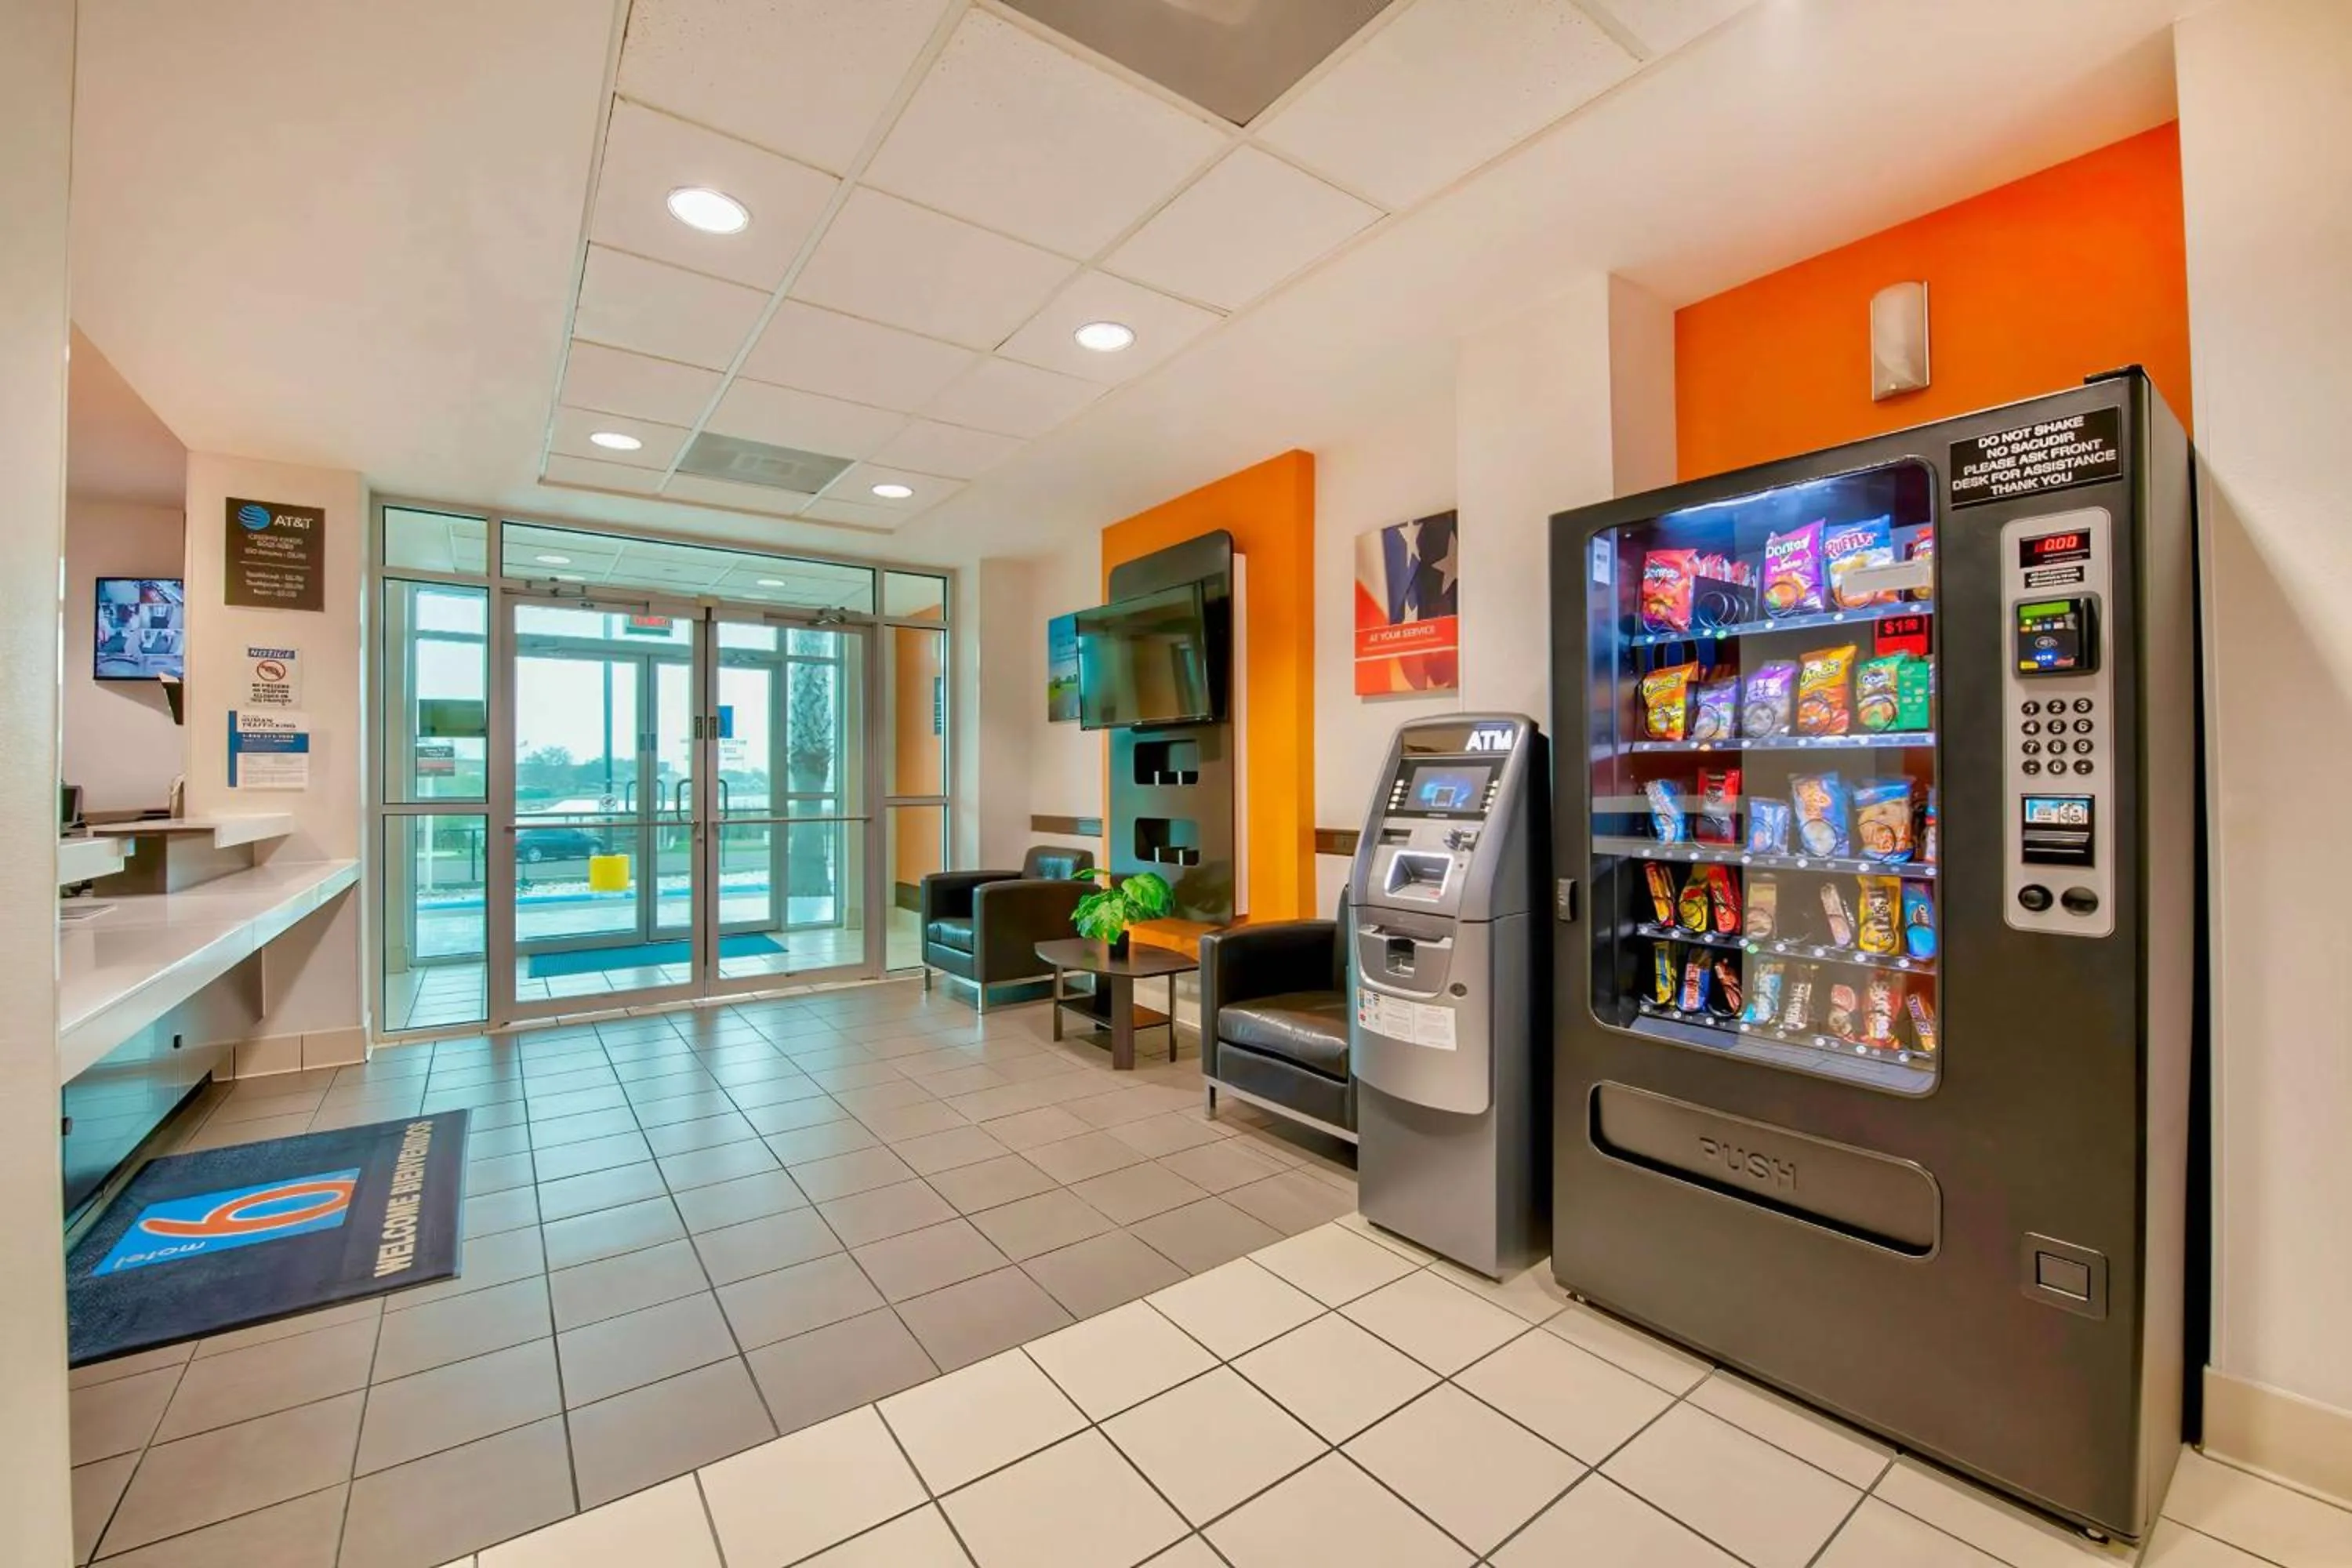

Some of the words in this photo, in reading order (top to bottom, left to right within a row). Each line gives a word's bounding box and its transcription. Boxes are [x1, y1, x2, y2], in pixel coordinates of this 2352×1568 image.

[1978, 435, 1999, 448] DO
[2002, 427, 2032, 443] NOT
[2034, 416, 2085, 436] SHAKE
[1987, 446, 2008, 459] NO
[2011, 431, 2075, 455] SACUDIR
[1963, 456, 2016, 476] PLEASE
[2019, 449, 2049, 469] ASK
[2050, 438, 2103, 459] FRONT
[1952, 475, 1989, 491] DESK
[1991, 468, 2020, 484] FOR
[2024, 449, 2116, 476] ASSISTANCE
[1991, 477, 2038, 495] THANK
[2041, 472, 2073, 486] YOU
[274, 514, 313, 529] AT&T
[1381, 630, 1402, 641] YOUR
[1403, 625, 1436, 637] SERVICE
[250, 648, 291, 659] NOTICE
[2053, 702, 2062, 712] 2
[2078, 700, 2089, 711] 3
[2053, 721, 2061, 731] 5
[2078, 721, 2089, 731] 6
[1465, 730, 1514, 751] ATM
[2027, 742, 2036, 753] 7
[2053, 762, 2061, 772] 0
[1699, 1137, 1797, 1190] PUSH
[373, 1194, 421, 1278] WELCOME
[114, 1240, 206, 1269] motel
